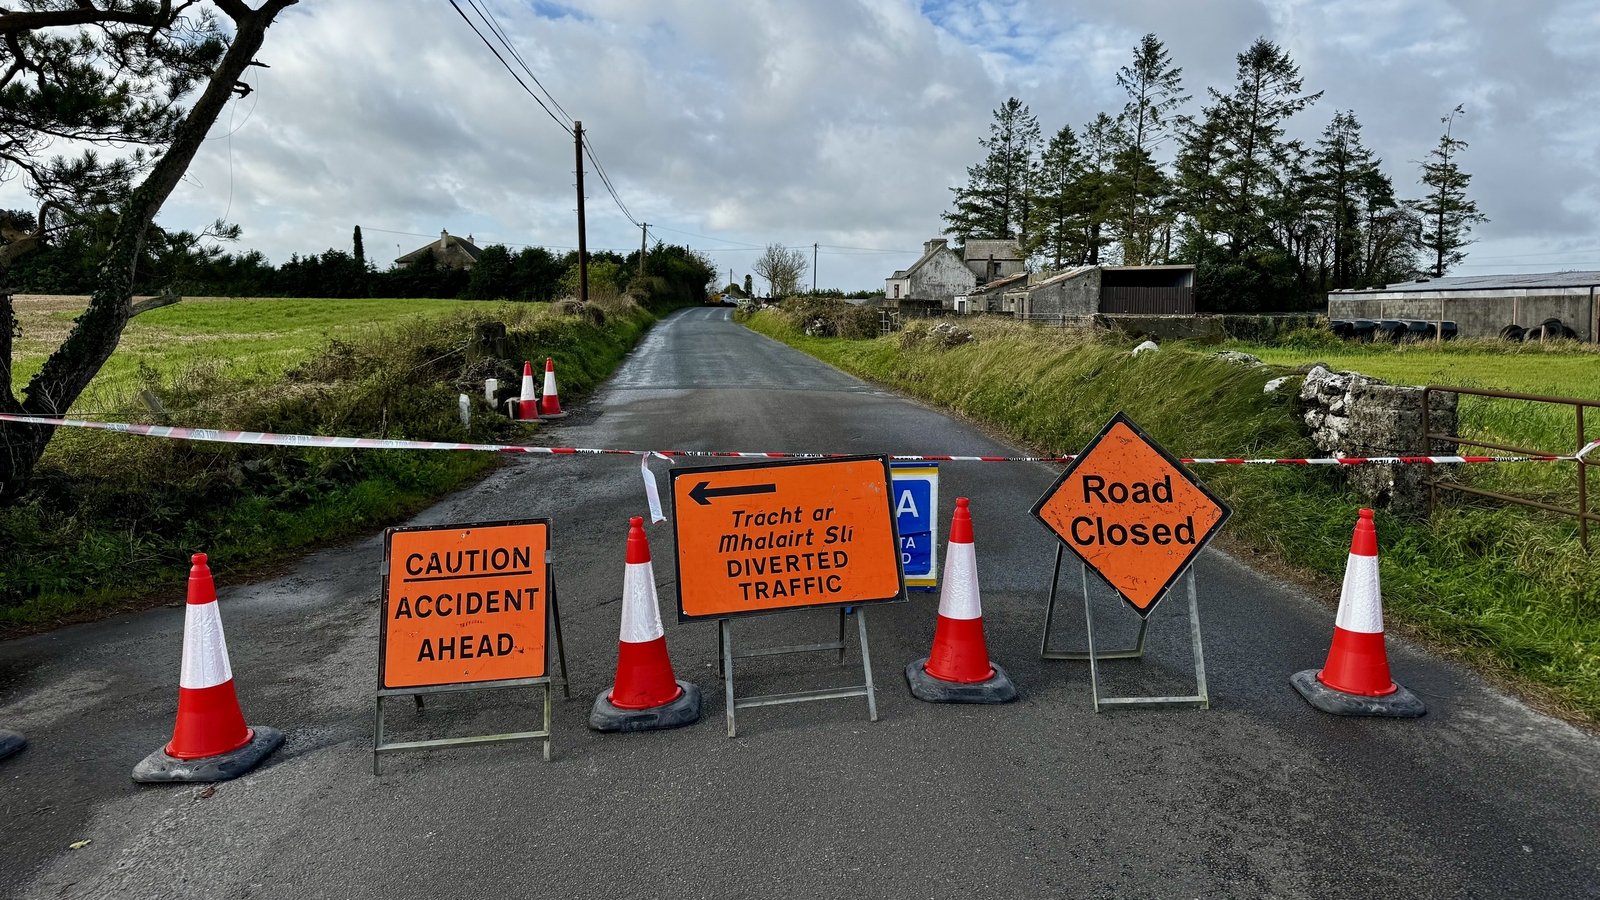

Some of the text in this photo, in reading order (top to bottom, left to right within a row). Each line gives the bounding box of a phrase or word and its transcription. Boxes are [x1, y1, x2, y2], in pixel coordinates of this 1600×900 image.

[1083, 475, 1173, 504] Road
[732, 506, 833, 527] Trácht ar
[824, 526, 853, 544] Slí
[1071, 516, 1195, 546] Closed
[405, 546, 531, 576] CAUTION
[727, 551, 848, 579] DIVERTED
[739, 573, 841, 600] TRAFFIC
[395, 588, 539, 619] ACCIDENT
[418, 633, 513, 661] AHEAD
